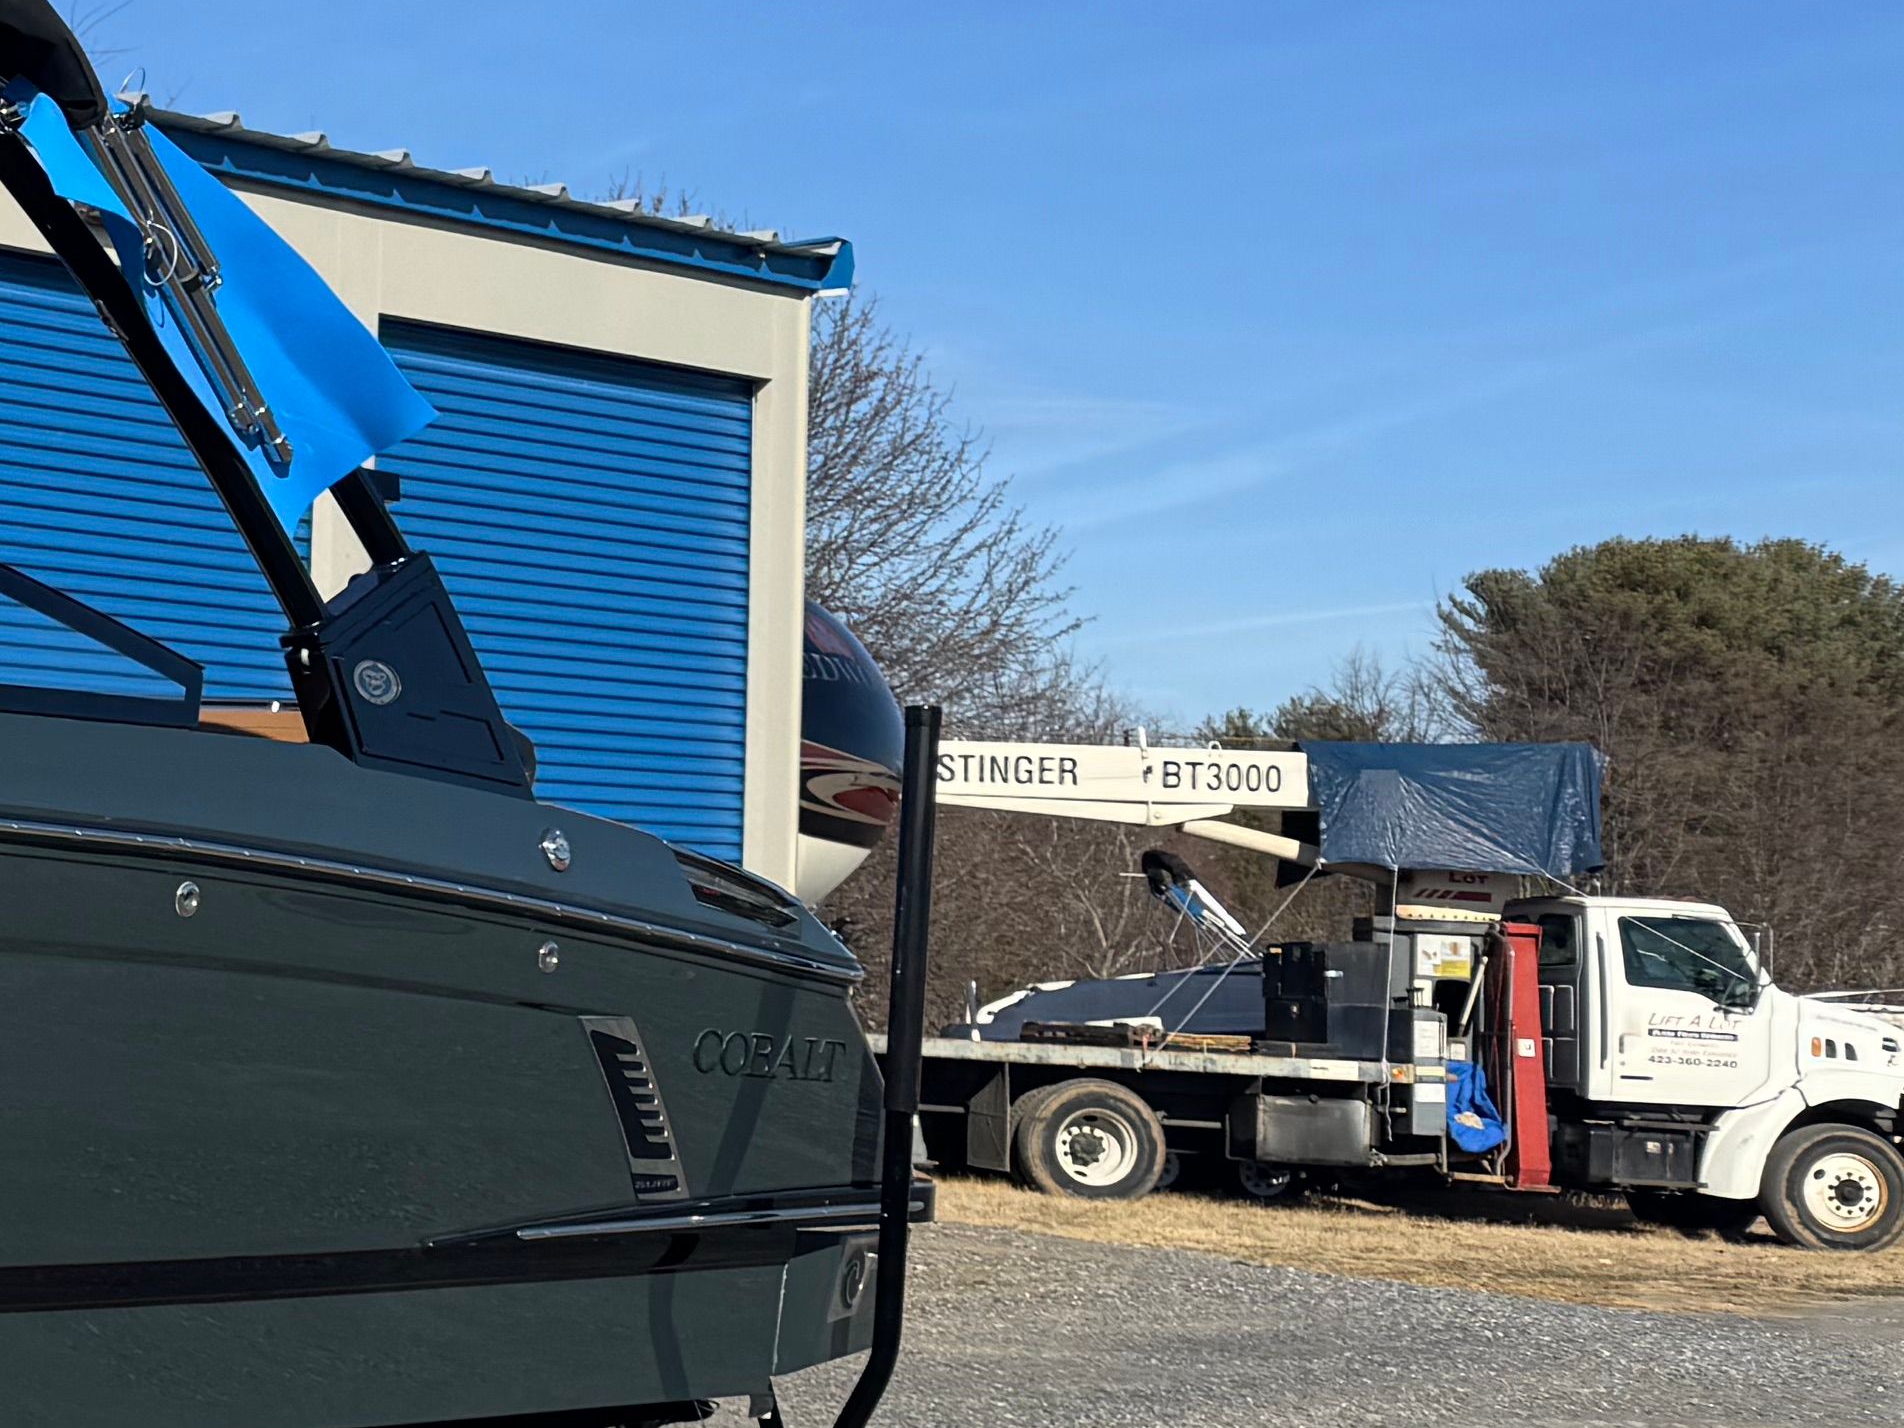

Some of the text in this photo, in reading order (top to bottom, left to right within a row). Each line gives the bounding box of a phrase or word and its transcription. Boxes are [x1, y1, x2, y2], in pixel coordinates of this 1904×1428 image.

[937, 753, 1282, 793] STINGER BT3000
[1648, 1013, 1685, 1026] LIFT
[1689, 1015, 1701, 1028] A
[693, 1028, 846, 1083] COBALT
